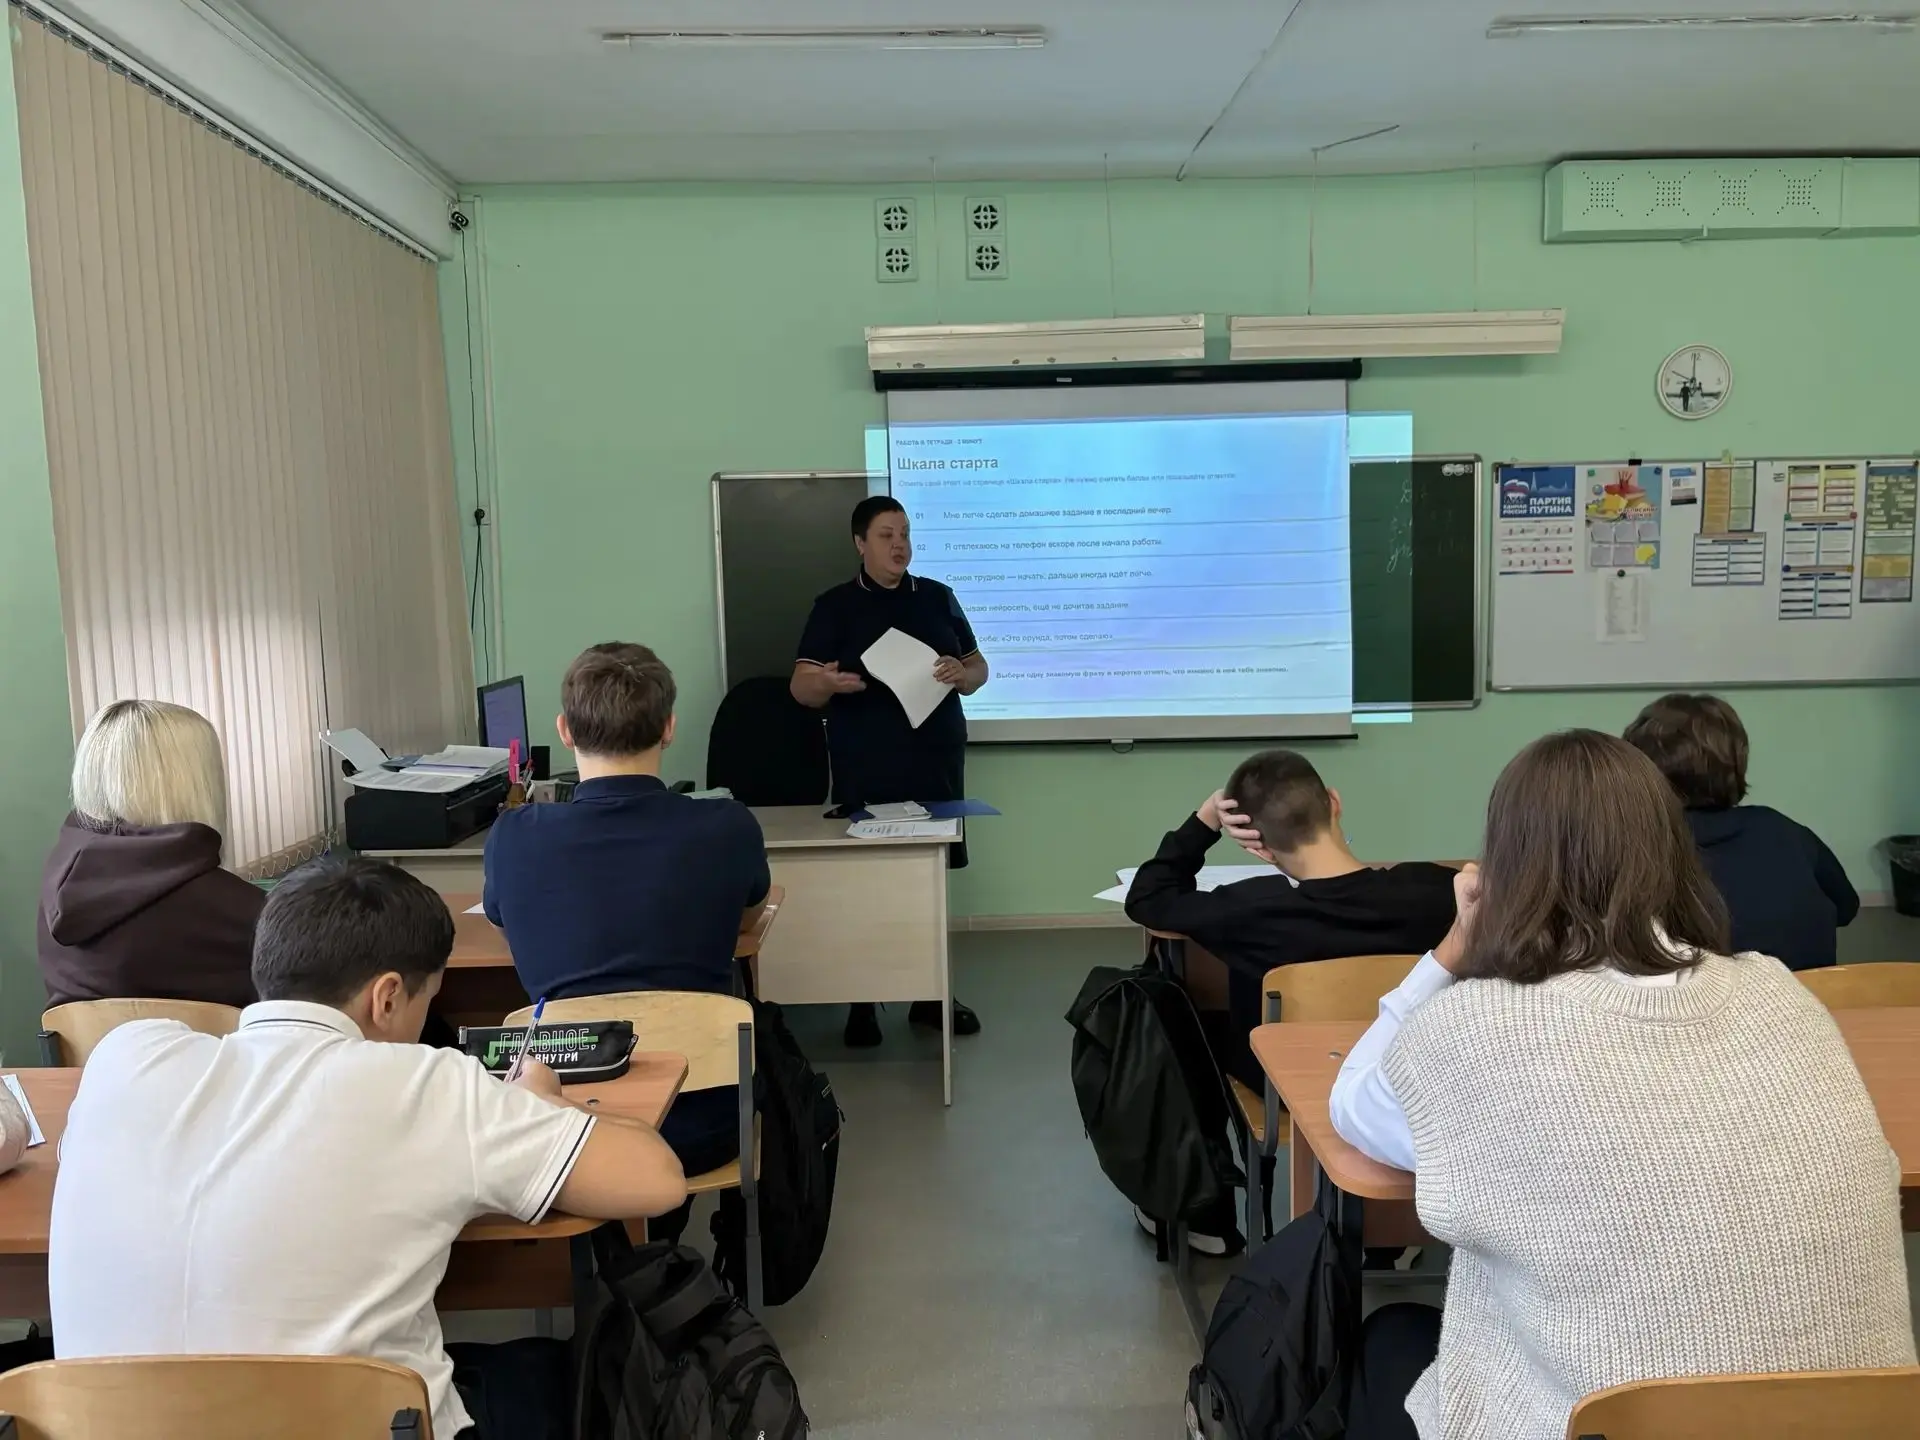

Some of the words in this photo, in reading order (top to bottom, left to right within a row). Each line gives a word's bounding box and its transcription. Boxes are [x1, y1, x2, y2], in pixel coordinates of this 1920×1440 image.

[897, 457, 945, 470] Шкала
[949, 458, 999, 472] старта
[1099, 476, 1126, 484] считать
[1126, 474, 1150, 483] баллы
[1151, 474, 1165, 482] или
[1529, 496, 1572, 506] ПАРТИЯ
[915, 512, 925, 520] 01
[943, 511, 960, 520] Мне
[962, 511, 984, 520] легче
[986, 510, 1017, 520] сделать
[1019, 509, 1060, 519] домашнее
[1062, 509, 1095, 517] задание
[1103, 506, 1146, 516] последний
[1529, 505, 1572, 514] ПУТИНА
[916, 543, 927, 551] 02
[944, 542, 951, 551] Я
[952, 542, 999, 551] отвлекаюсь
[1000, 542, 1010, 550] на
[1012, 540, 1047, 551] телефон
[1047, 540, 1075, 549] вскоре
[1076, 540, 1100, 548] после
[1101, 539, 1131, 547] начала
[946, 573, 972, 582] Самое
[974, 574, 1005, 583] трудное
[1047, 571, 1079, 580] дальше
[1080, 571, 1108, 580] иногда
[1108, 569, 1127, 579] идёт
[989, 602, 1031, 613] нейросеть,
[1032, 602, 1050, 611] ещё
[1062, 602, 1095, 612] дочитав
[1001, 634, 1020, 643] «Это
[1022, 634, 1052, 643] ерунда,
[1054, 634, 1078, 642] потом
[996, 671, 1025, 680] Выбери
[1026, 672, 1044, 680] одну
[1045, 671, 1081, 679] знакомую
[1082, 669, 1105, 679] фразу
[1113, 669, 1142, 678] коротко
[1222, 667, 1237, 675] ней
[1237, 666, 1254, 674] тебе
[500, 1028, 597, 1054] ГЛАВНОЕ,
